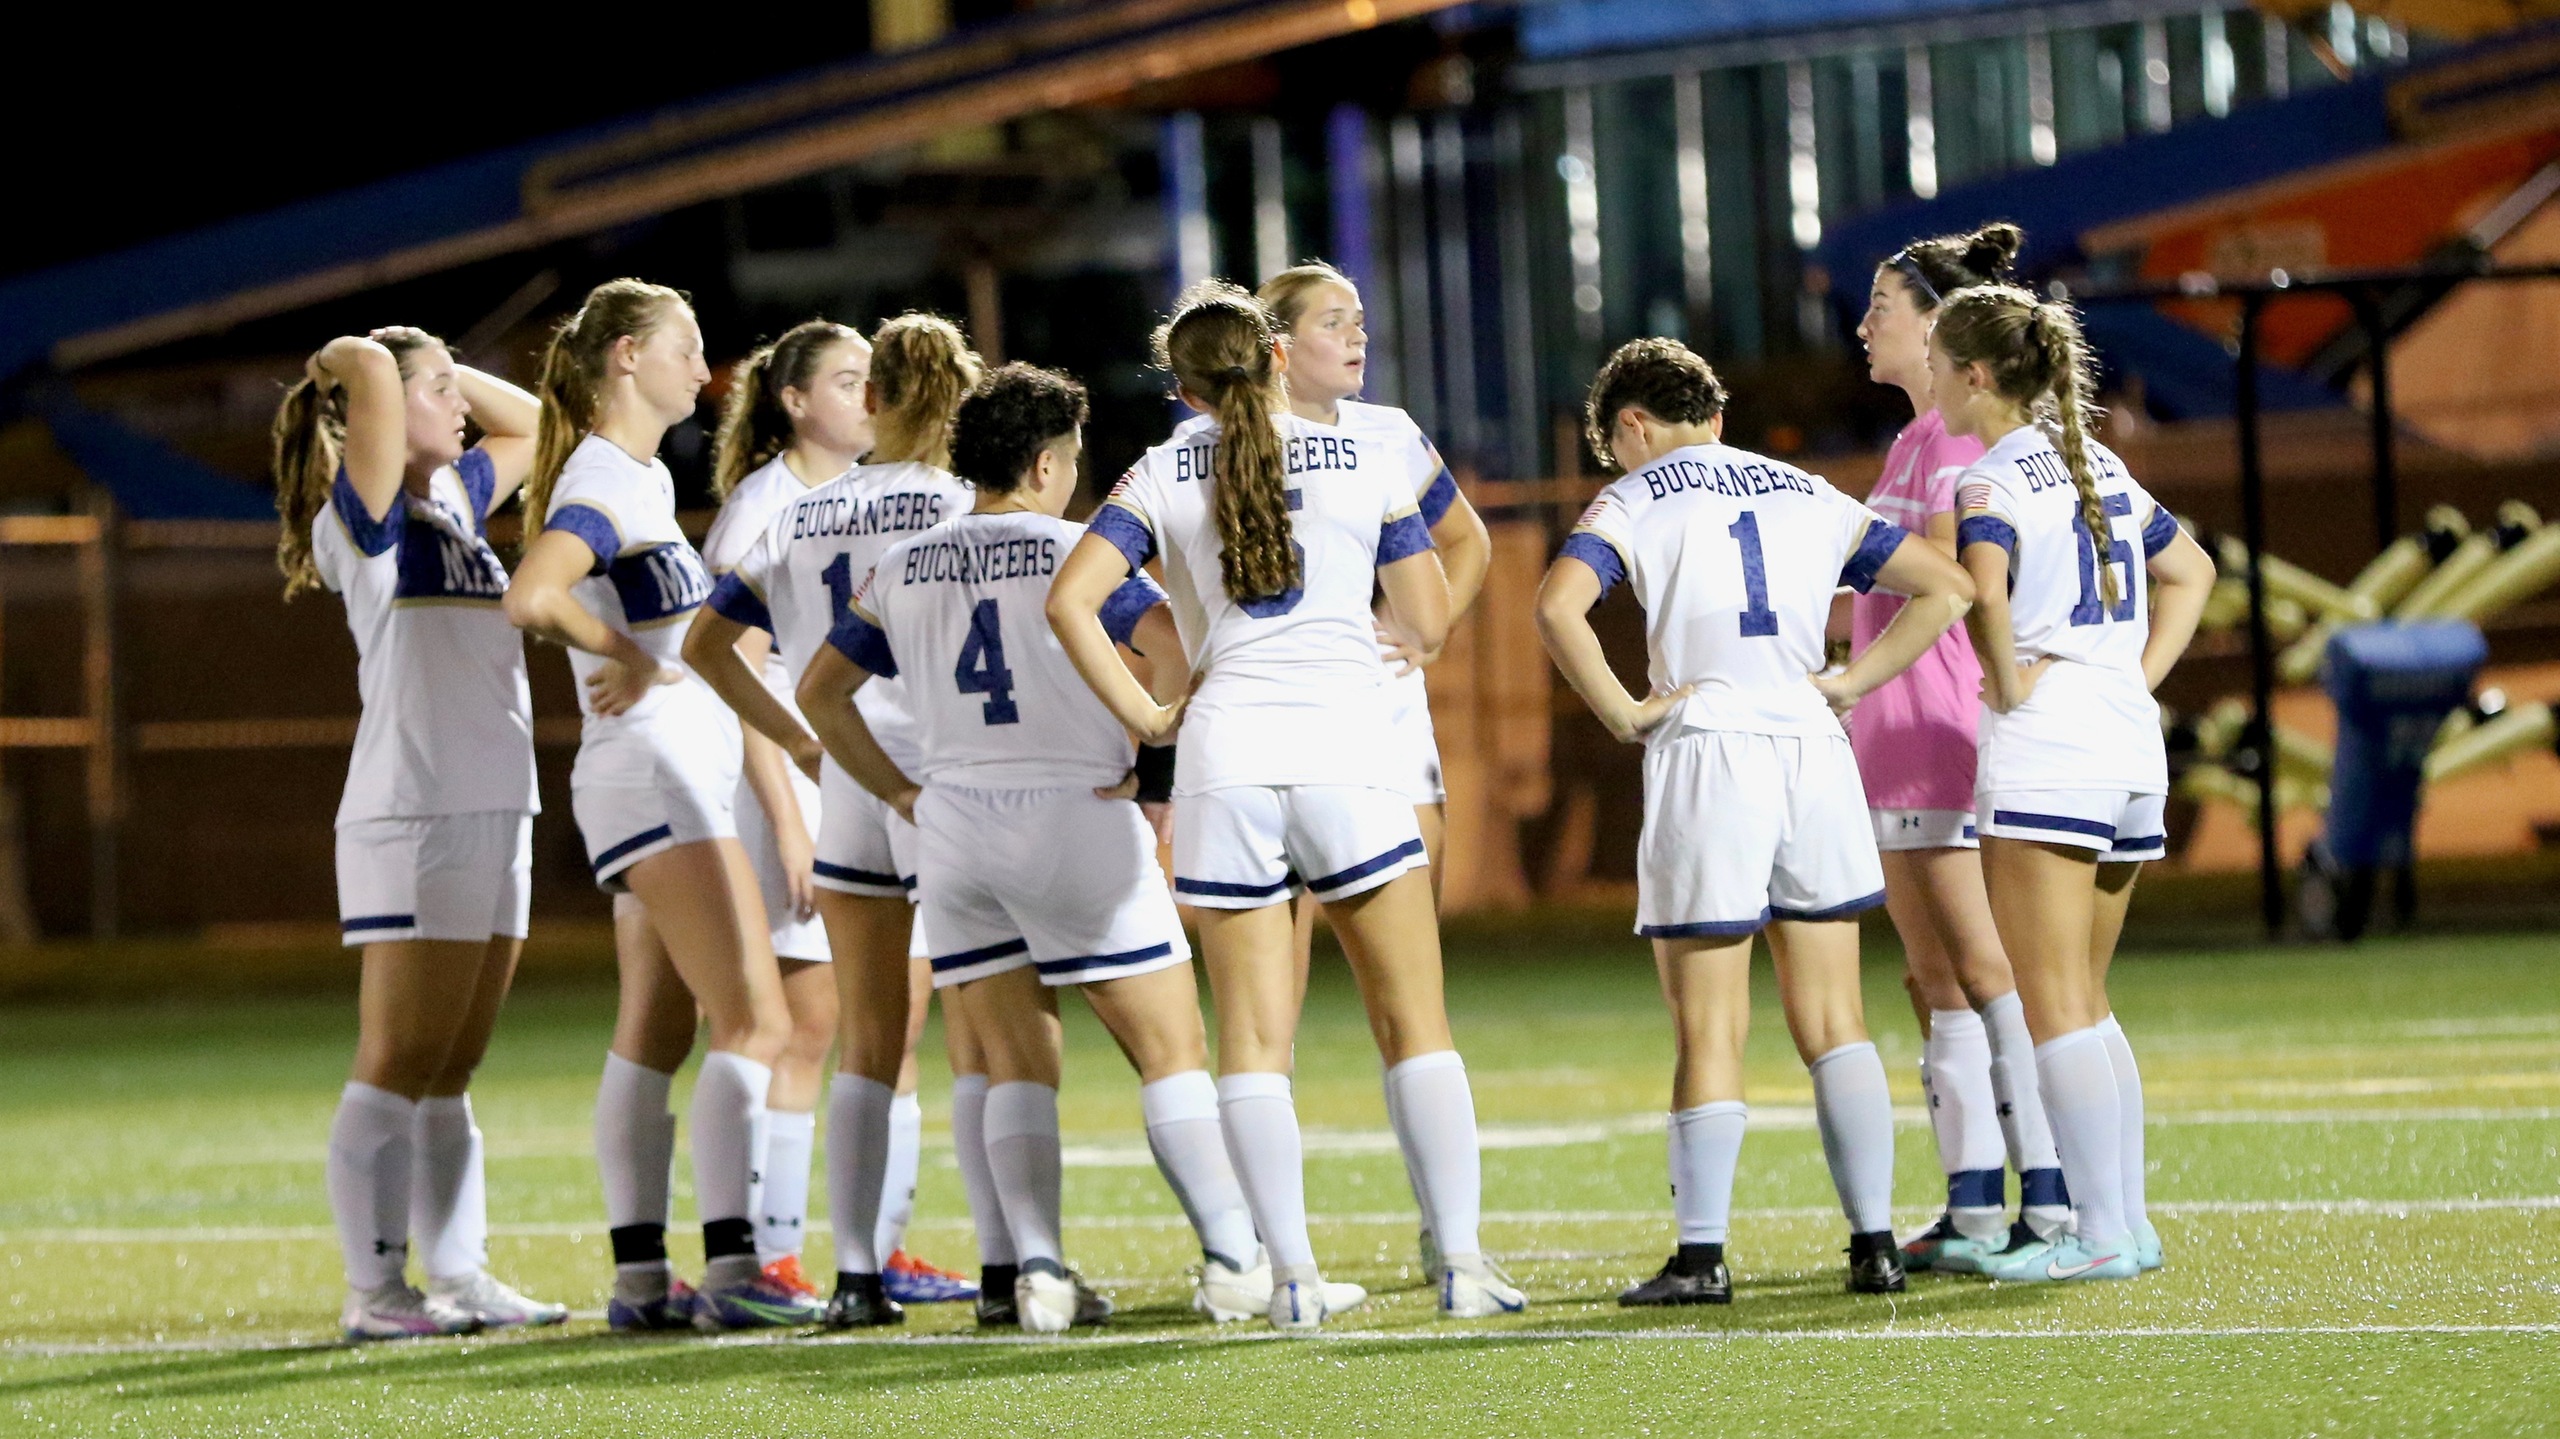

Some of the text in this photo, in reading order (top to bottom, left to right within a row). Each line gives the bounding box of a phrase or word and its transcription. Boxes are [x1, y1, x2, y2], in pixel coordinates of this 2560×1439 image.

[1641, 460, 1814, 501] BUCCANEERS
[794, 492, 943, 540] BUCCANEERS
[904, 538, 1056, 585] BUCCANEERS
[1728, 510, 1779, 637] 1
[955, 598, 1020, 726] 4
